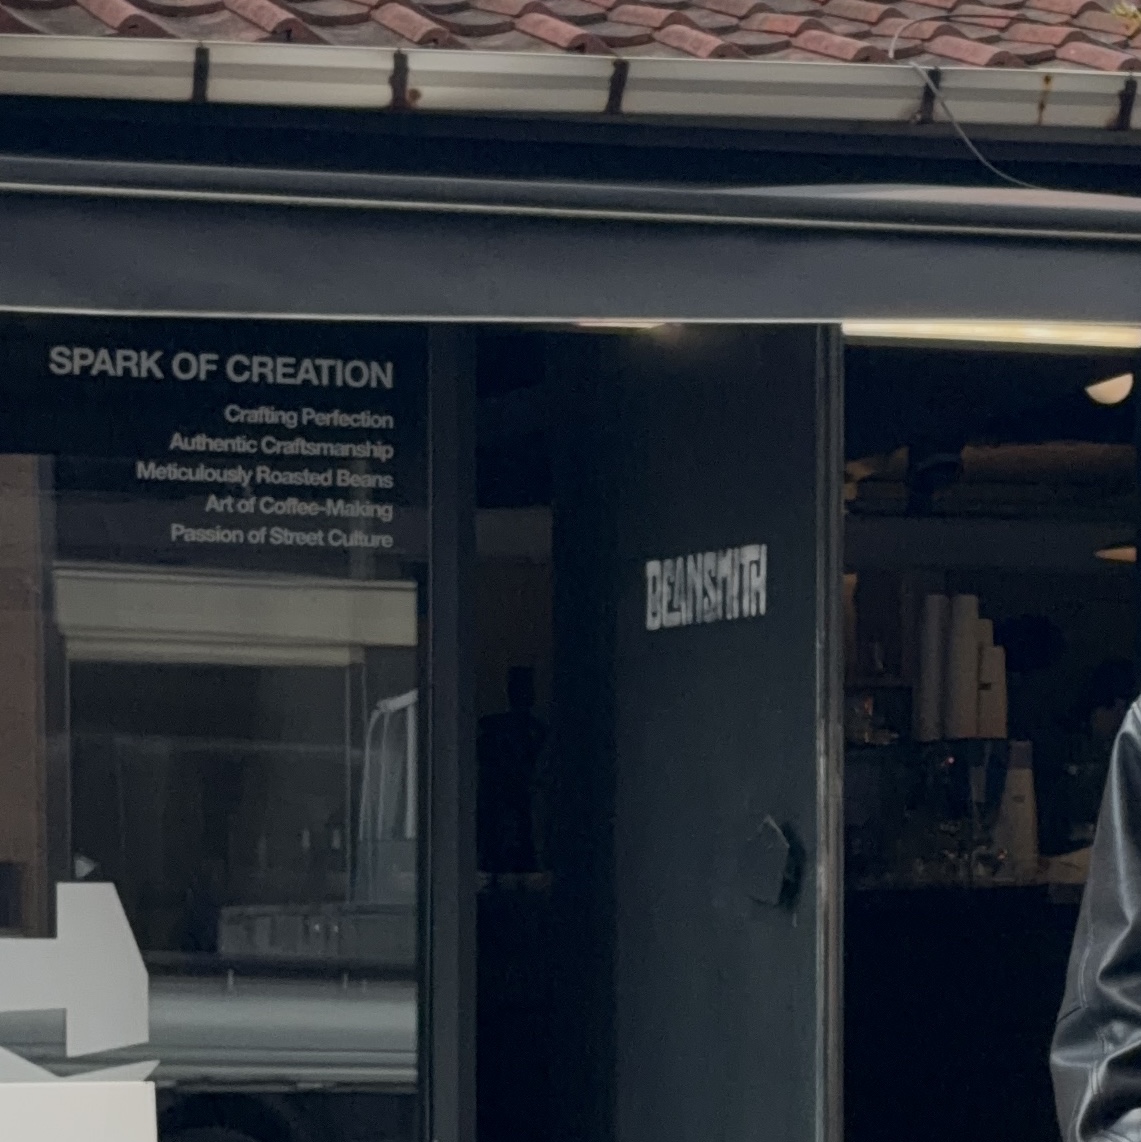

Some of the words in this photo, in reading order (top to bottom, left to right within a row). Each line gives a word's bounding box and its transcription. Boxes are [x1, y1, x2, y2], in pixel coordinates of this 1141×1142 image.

[49, 346, 165, 379] SPARK
[171, 353, 219, 380] OF
[226, 354, 394, 388] CREATION
[224, 404, 298, 428] Crafting
[302, 406, 394, 429] Perfection
[169, 432, 258, 454] Authentic
[261, 436, 394, 462] Craftsmanship
[136, 460, 253, 487] Meticulously
[256, 464, 332, 487] Roasted
[337, 467, 394, 488] Beans
[205, 495, 233, 514] Art
[238, 496, 257, 514] of
[260, 497, 394, 521] Coffee-Making
[171, 523, 244, 544] Passion
[248, 524, 267, 544] of
[269, 526, 325, 547] Street
[327, 528, 394, 548] Culture
[645, 543, 768, 631] BEANSMITH
